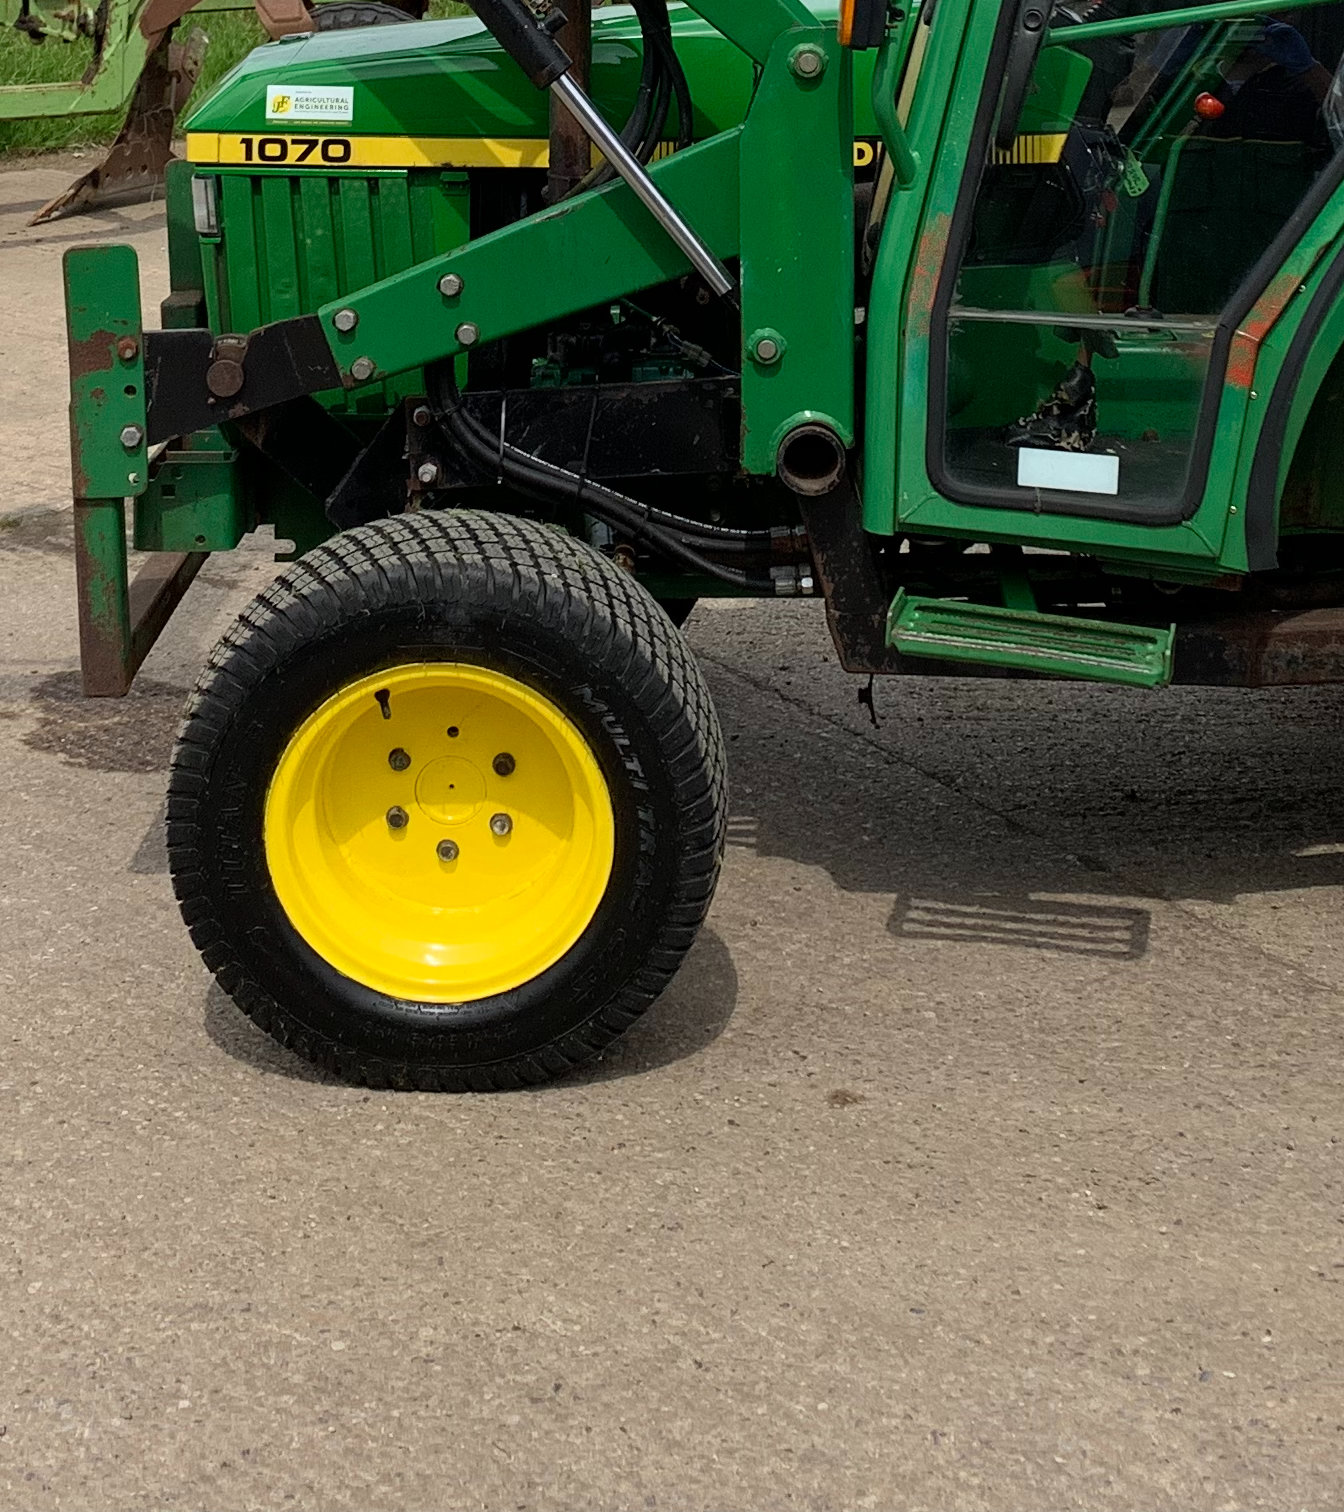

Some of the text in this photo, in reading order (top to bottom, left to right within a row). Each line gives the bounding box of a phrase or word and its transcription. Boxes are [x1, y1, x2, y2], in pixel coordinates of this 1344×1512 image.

[294, 96, 349, 104] AGRICULTURAL
[294, 103, 349, 111] ENGINEERING
[239, 137, 352, 164] 1070
[568, 683, 650, 792] MULTI
